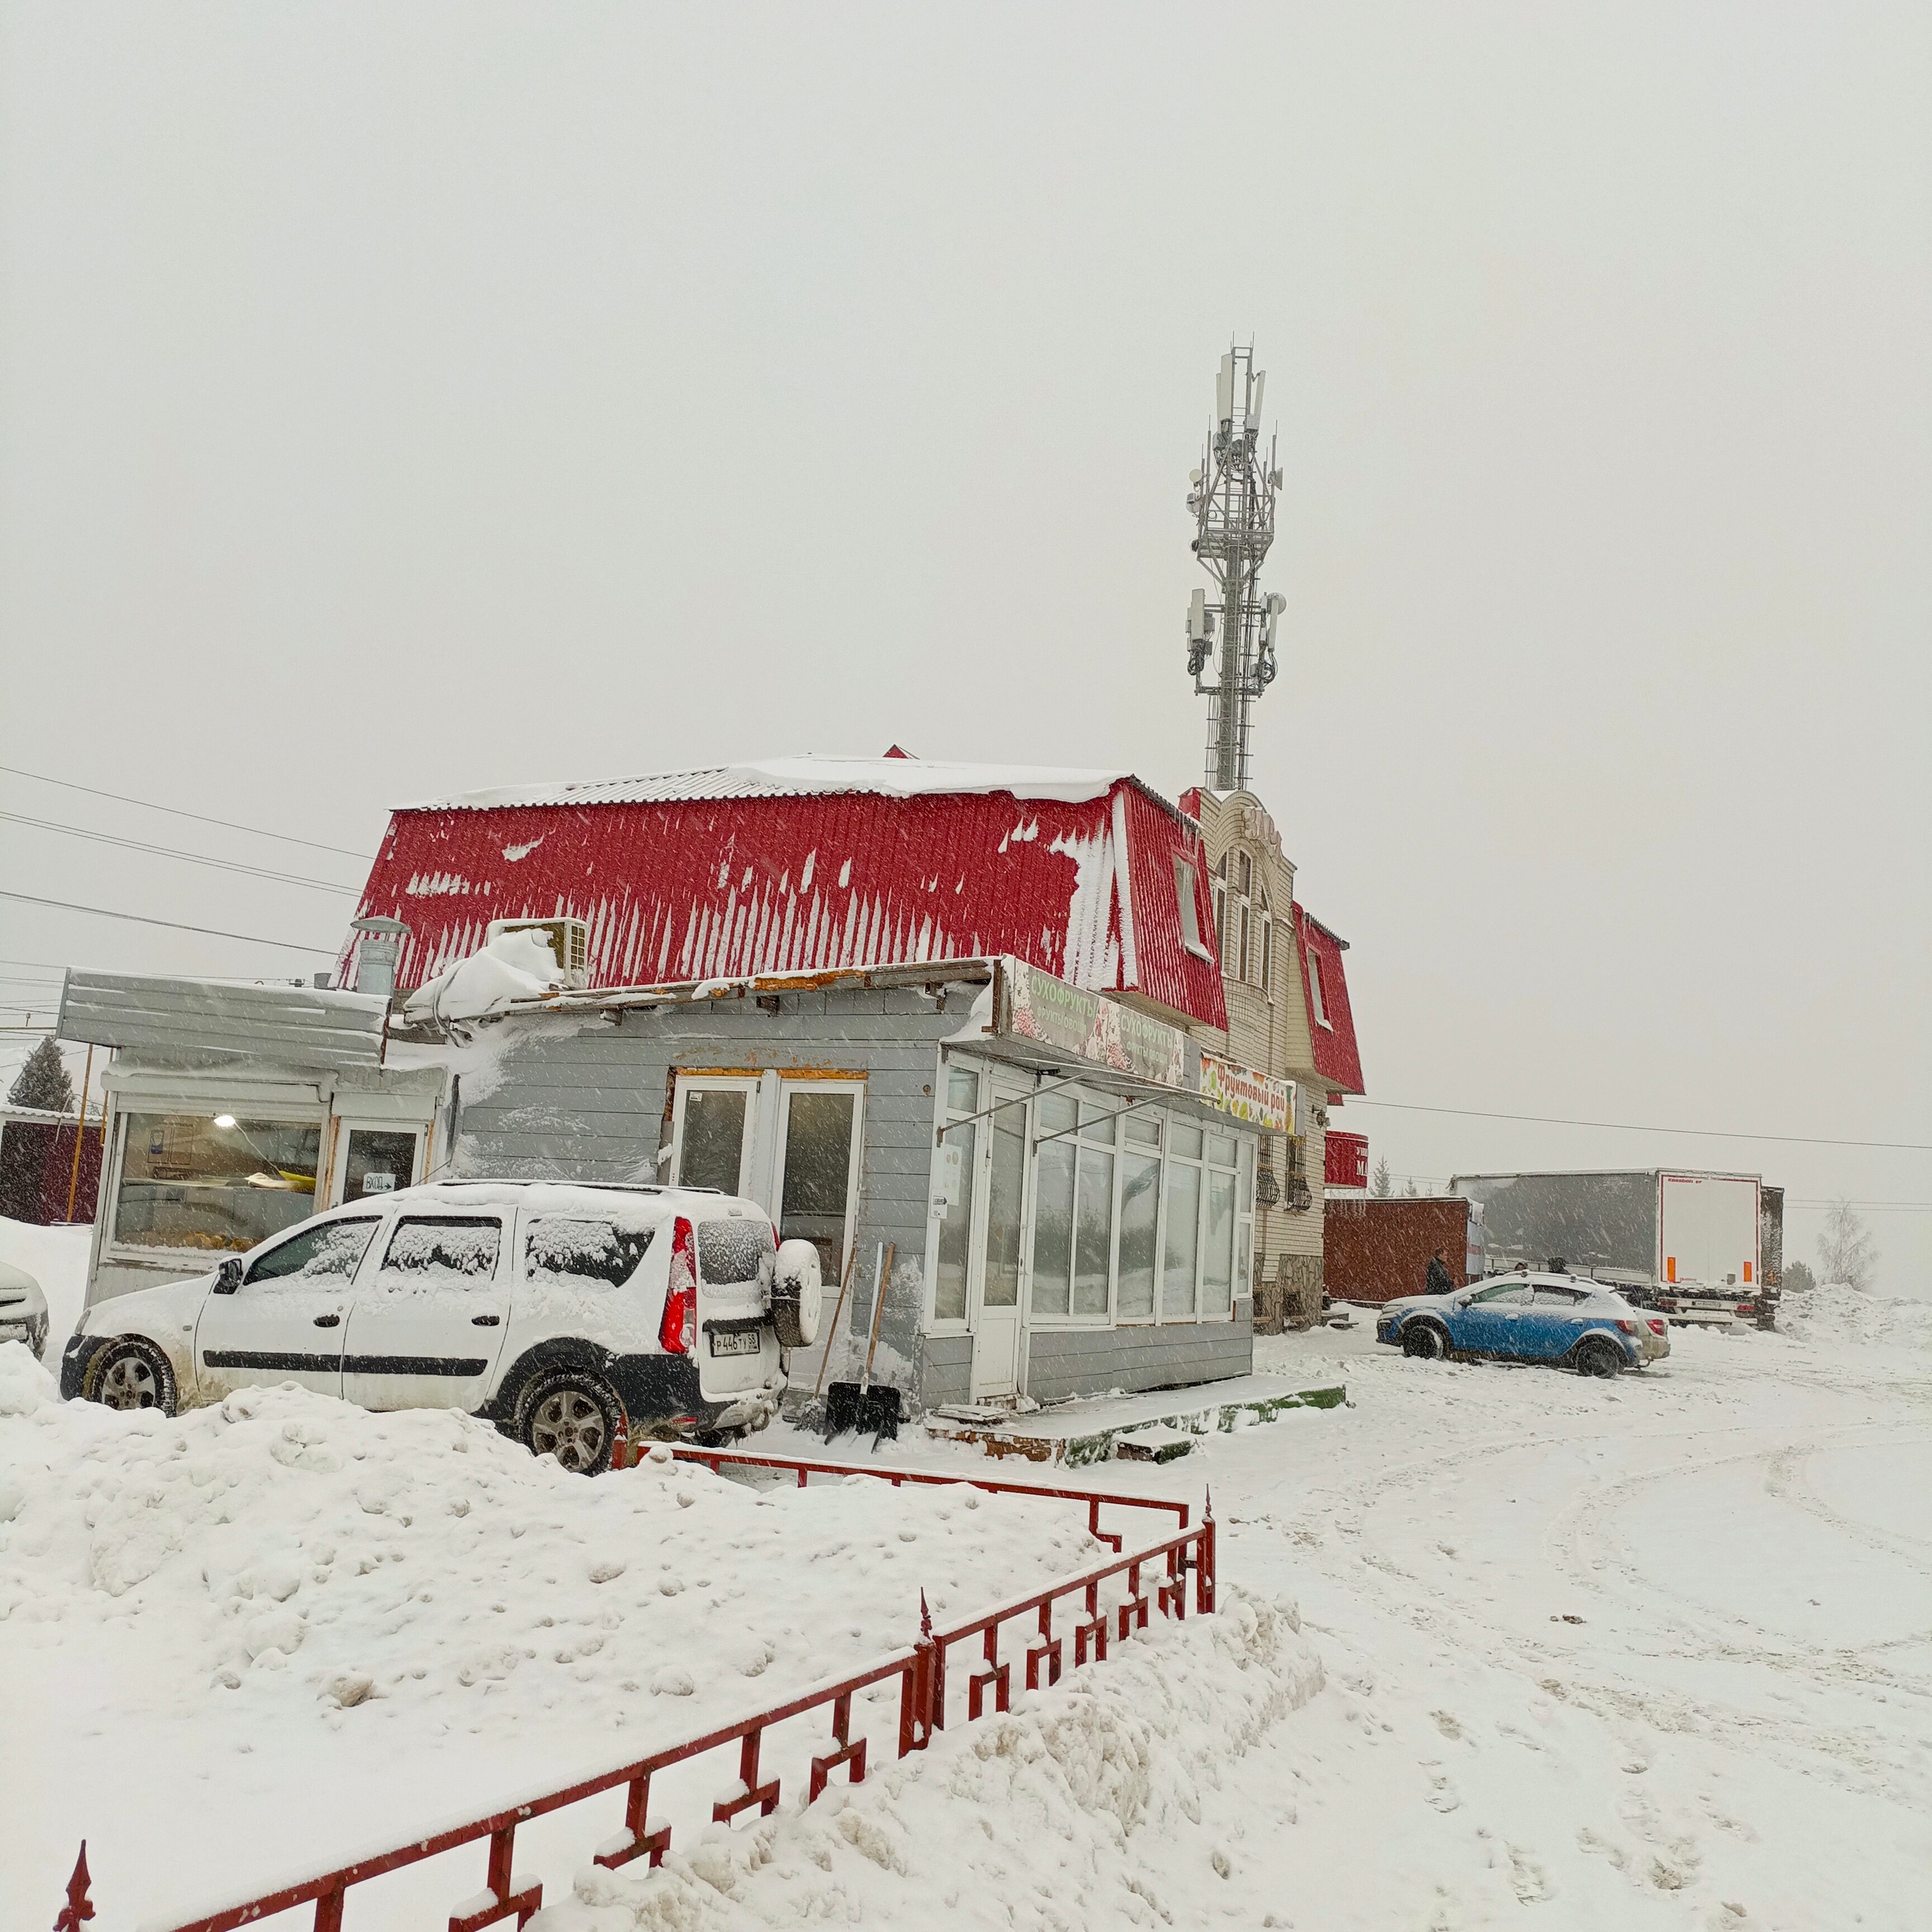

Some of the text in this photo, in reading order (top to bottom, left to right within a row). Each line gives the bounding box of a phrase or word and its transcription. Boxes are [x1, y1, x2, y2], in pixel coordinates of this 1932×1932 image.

[1031, 976, 1096, 1018] СУХОФРУКТЫ
[1037, 1006, 1086, 1036] ФРУКТЫ ОВОЩИ
[1121, 1014, 1173, 1049] СУХОФРУКТЫ
[1218, 1063, 1285, 1114] Фруктовый рай
[366, 1176, 383, 1190] ВХОД
